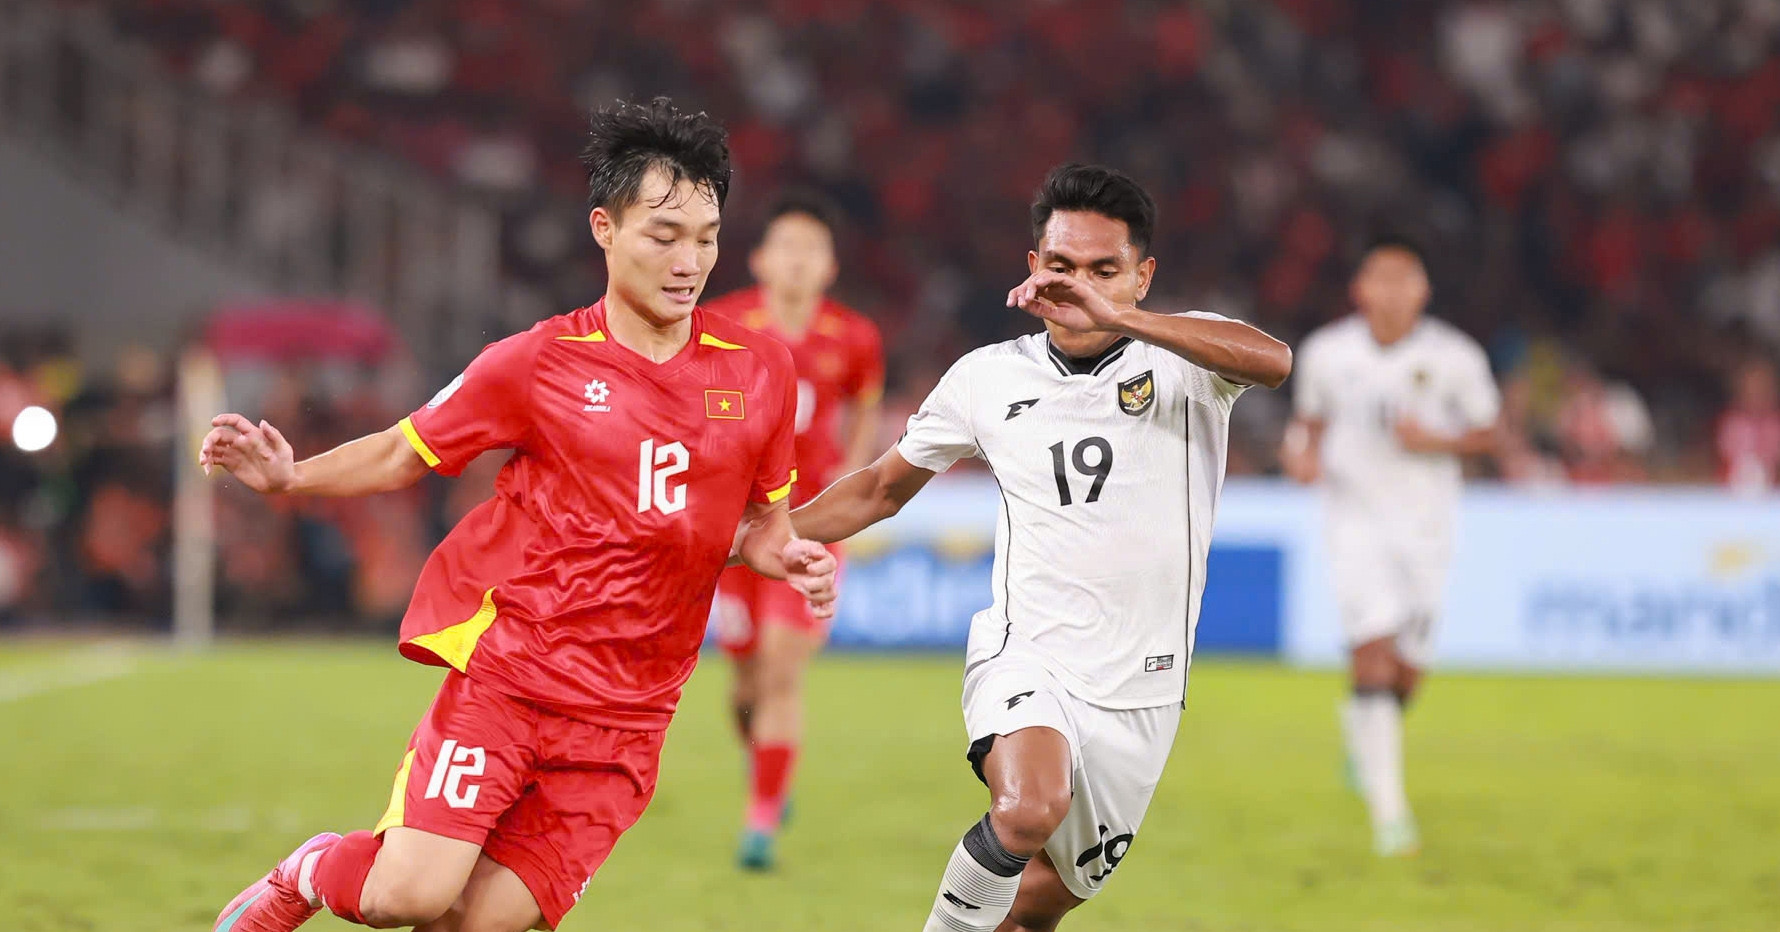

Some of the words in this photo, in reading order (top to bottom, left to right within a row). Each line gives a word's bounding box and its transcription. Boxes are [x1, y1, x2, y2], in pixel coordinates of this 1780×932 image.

[637, 438, 690, 515] 12
[1048, 436, 1113, 506] 19
[424, 739, 487, 809] 12
[1075, 824, 1134, 882] 19
